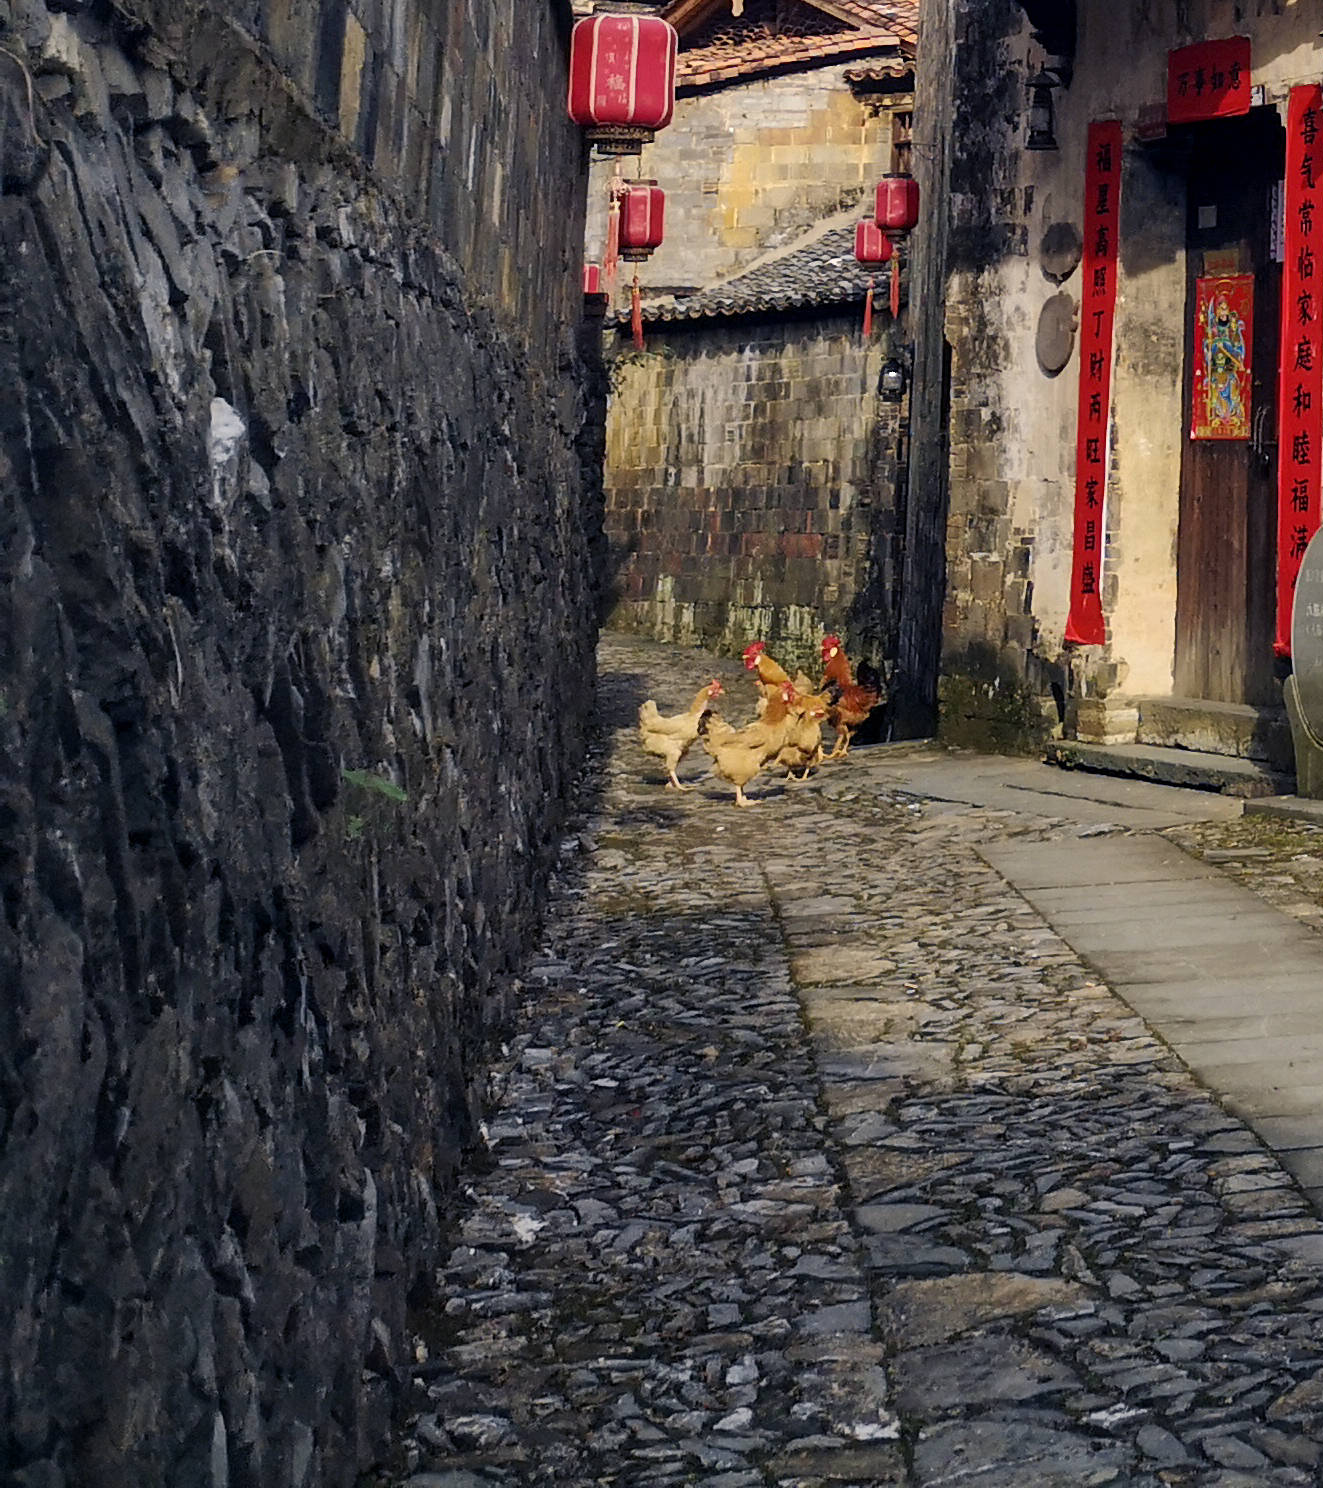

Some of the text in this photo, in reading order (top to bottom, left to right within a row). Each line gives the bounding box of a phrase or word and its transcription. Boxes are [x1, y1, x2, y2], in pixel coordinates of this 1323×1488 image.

[1177, 61, 1242, 97] 万事如意
[1081, 143, 1112, 594] 福星高照丁财两旺家昌盛
[1290, 109, 1320, 589] 喜气常临家庭和睦福满
